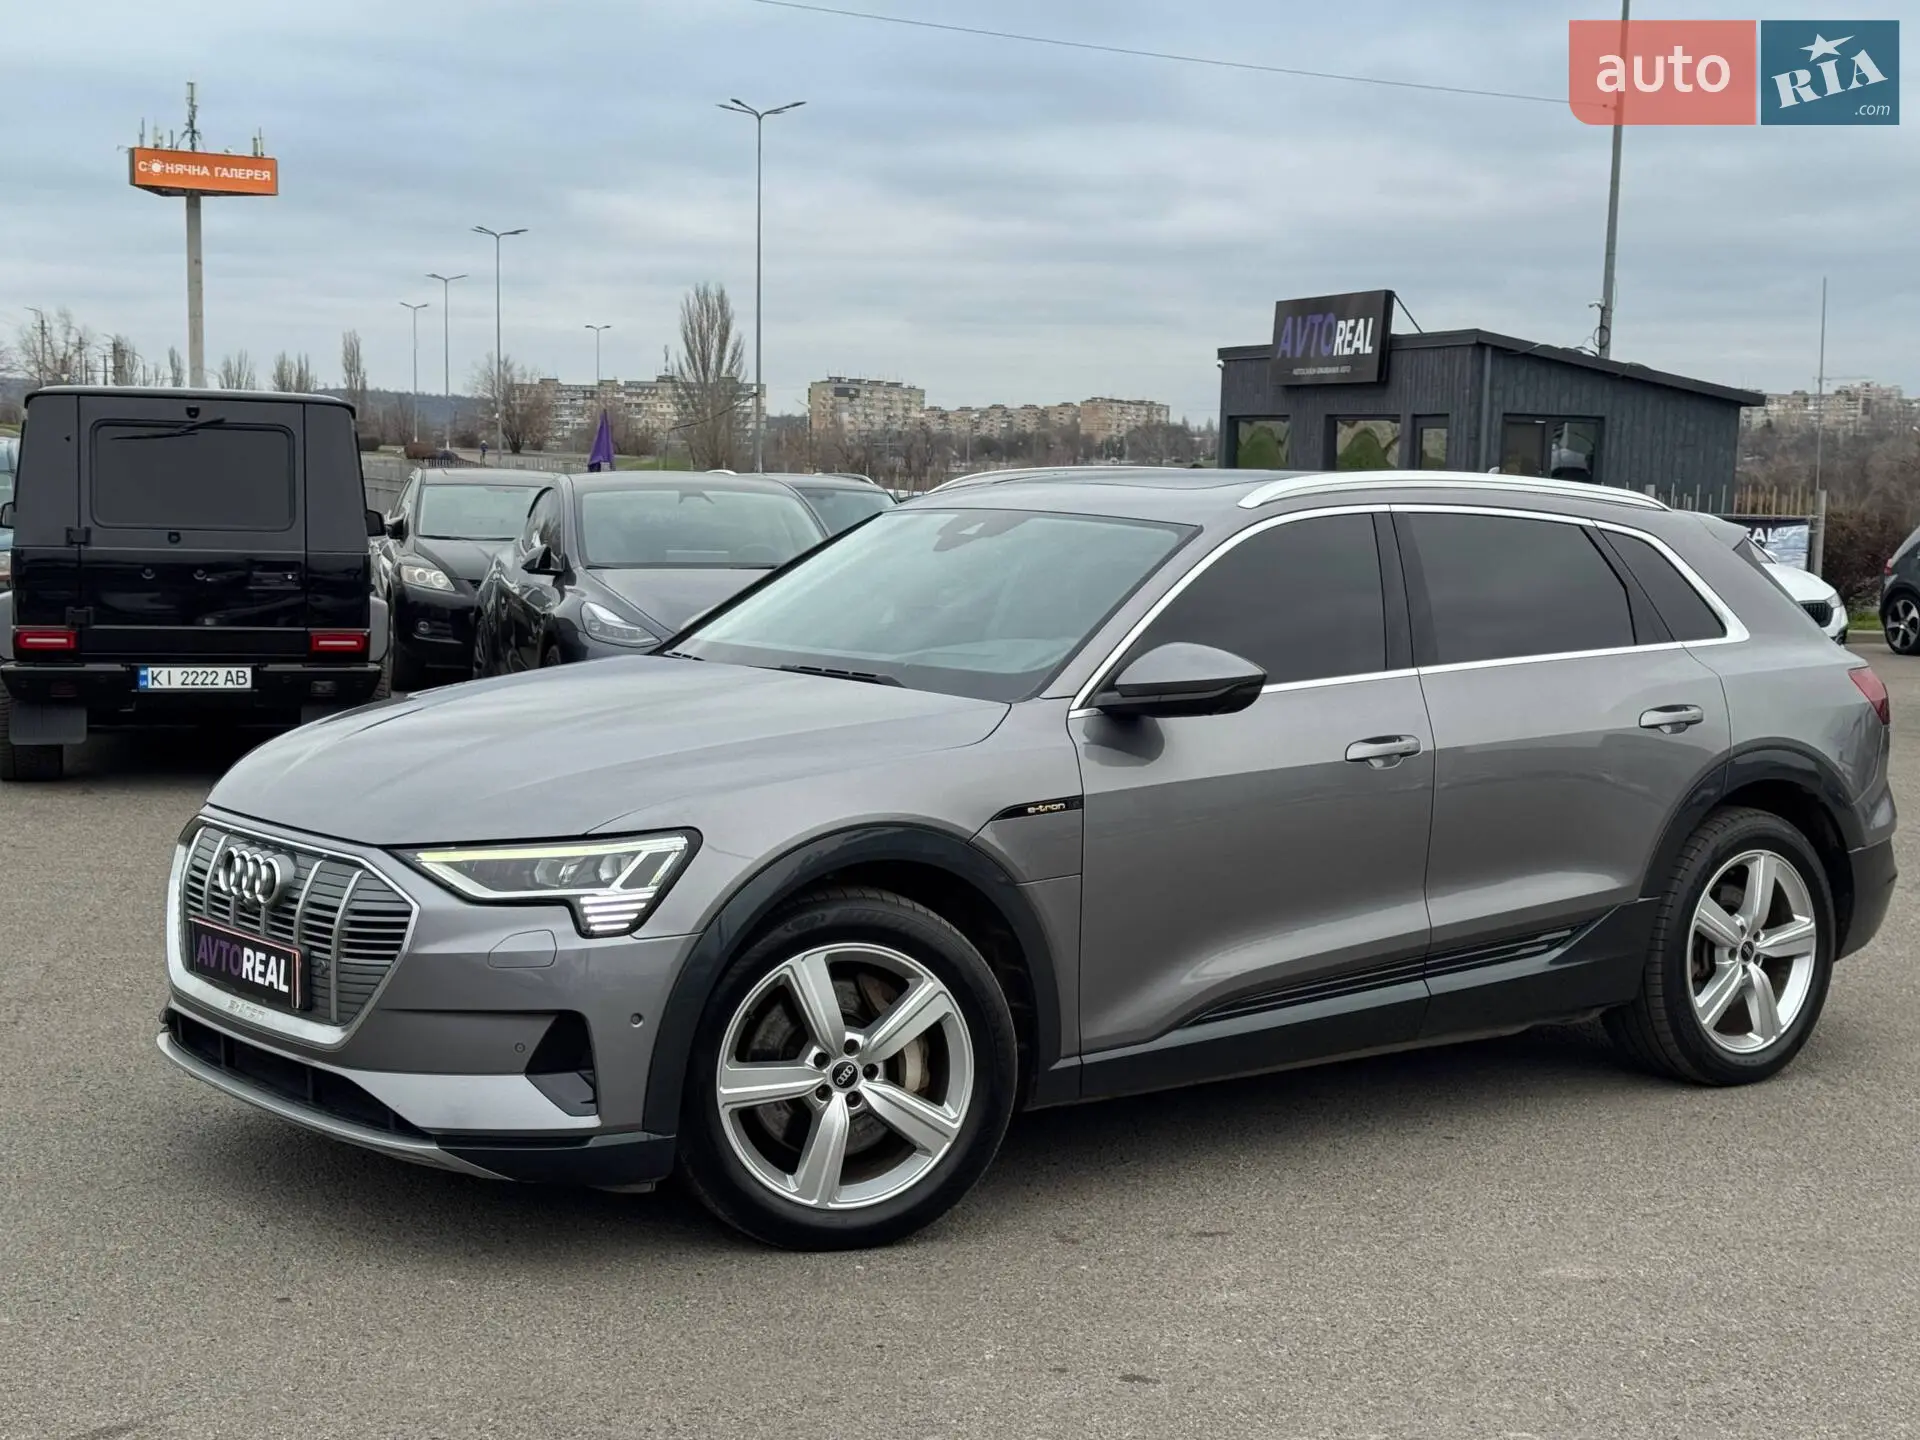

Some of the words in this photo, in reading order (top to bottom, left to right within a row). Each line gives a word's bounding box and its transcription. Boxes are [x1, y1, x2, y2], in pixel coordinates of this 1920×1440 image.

[214, 166, 271, 181] ГАЛЕРЕЯ
[151, 670, 172, 686] KI
[180, 670, 219, 686] 2222
[224, 670, 248, 686] AB
[1027, 803, 1066, 813] e-tron
